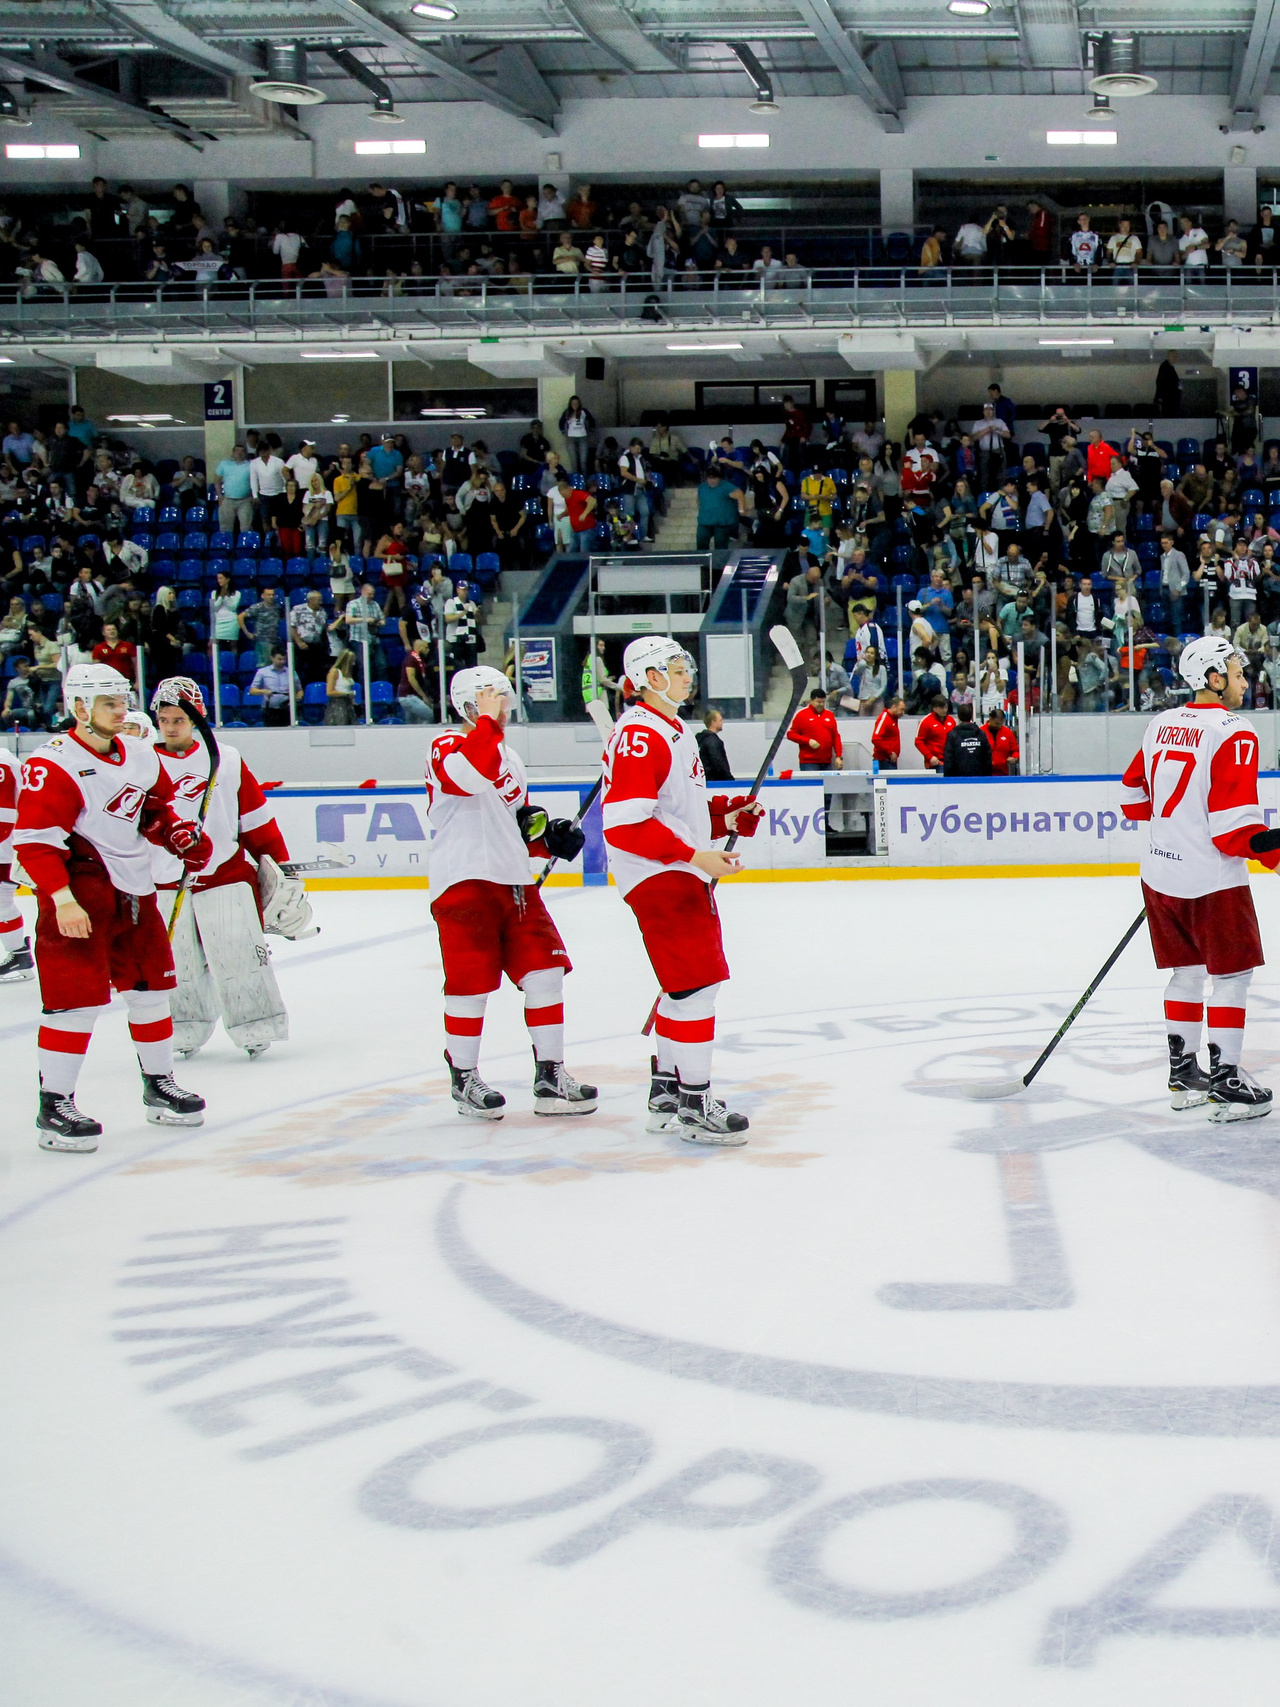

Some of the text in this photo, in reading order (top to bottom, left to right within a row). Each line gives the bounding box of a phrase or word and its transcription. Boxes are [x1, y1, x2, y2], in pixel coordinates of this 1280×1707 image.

[213, 384, 225, 404] 2
[1238, 370, 1250, 390] 3
[207, 408, 232, 416] СЕКТОР
[616, 730, 650, 759] 45
[1155, 725, 1205, 749] VORONIN
[1233, 738, 1256, 766] 17
[1150, 748, 1198, 819] 17
[316, 802, 438, 842] ГА
[769, 803, 1140, 844] Куб Губернатора
[878, 795, 887, 844] СПОРТМАКС
[714, 998, 1123, 1055] КУБОК
